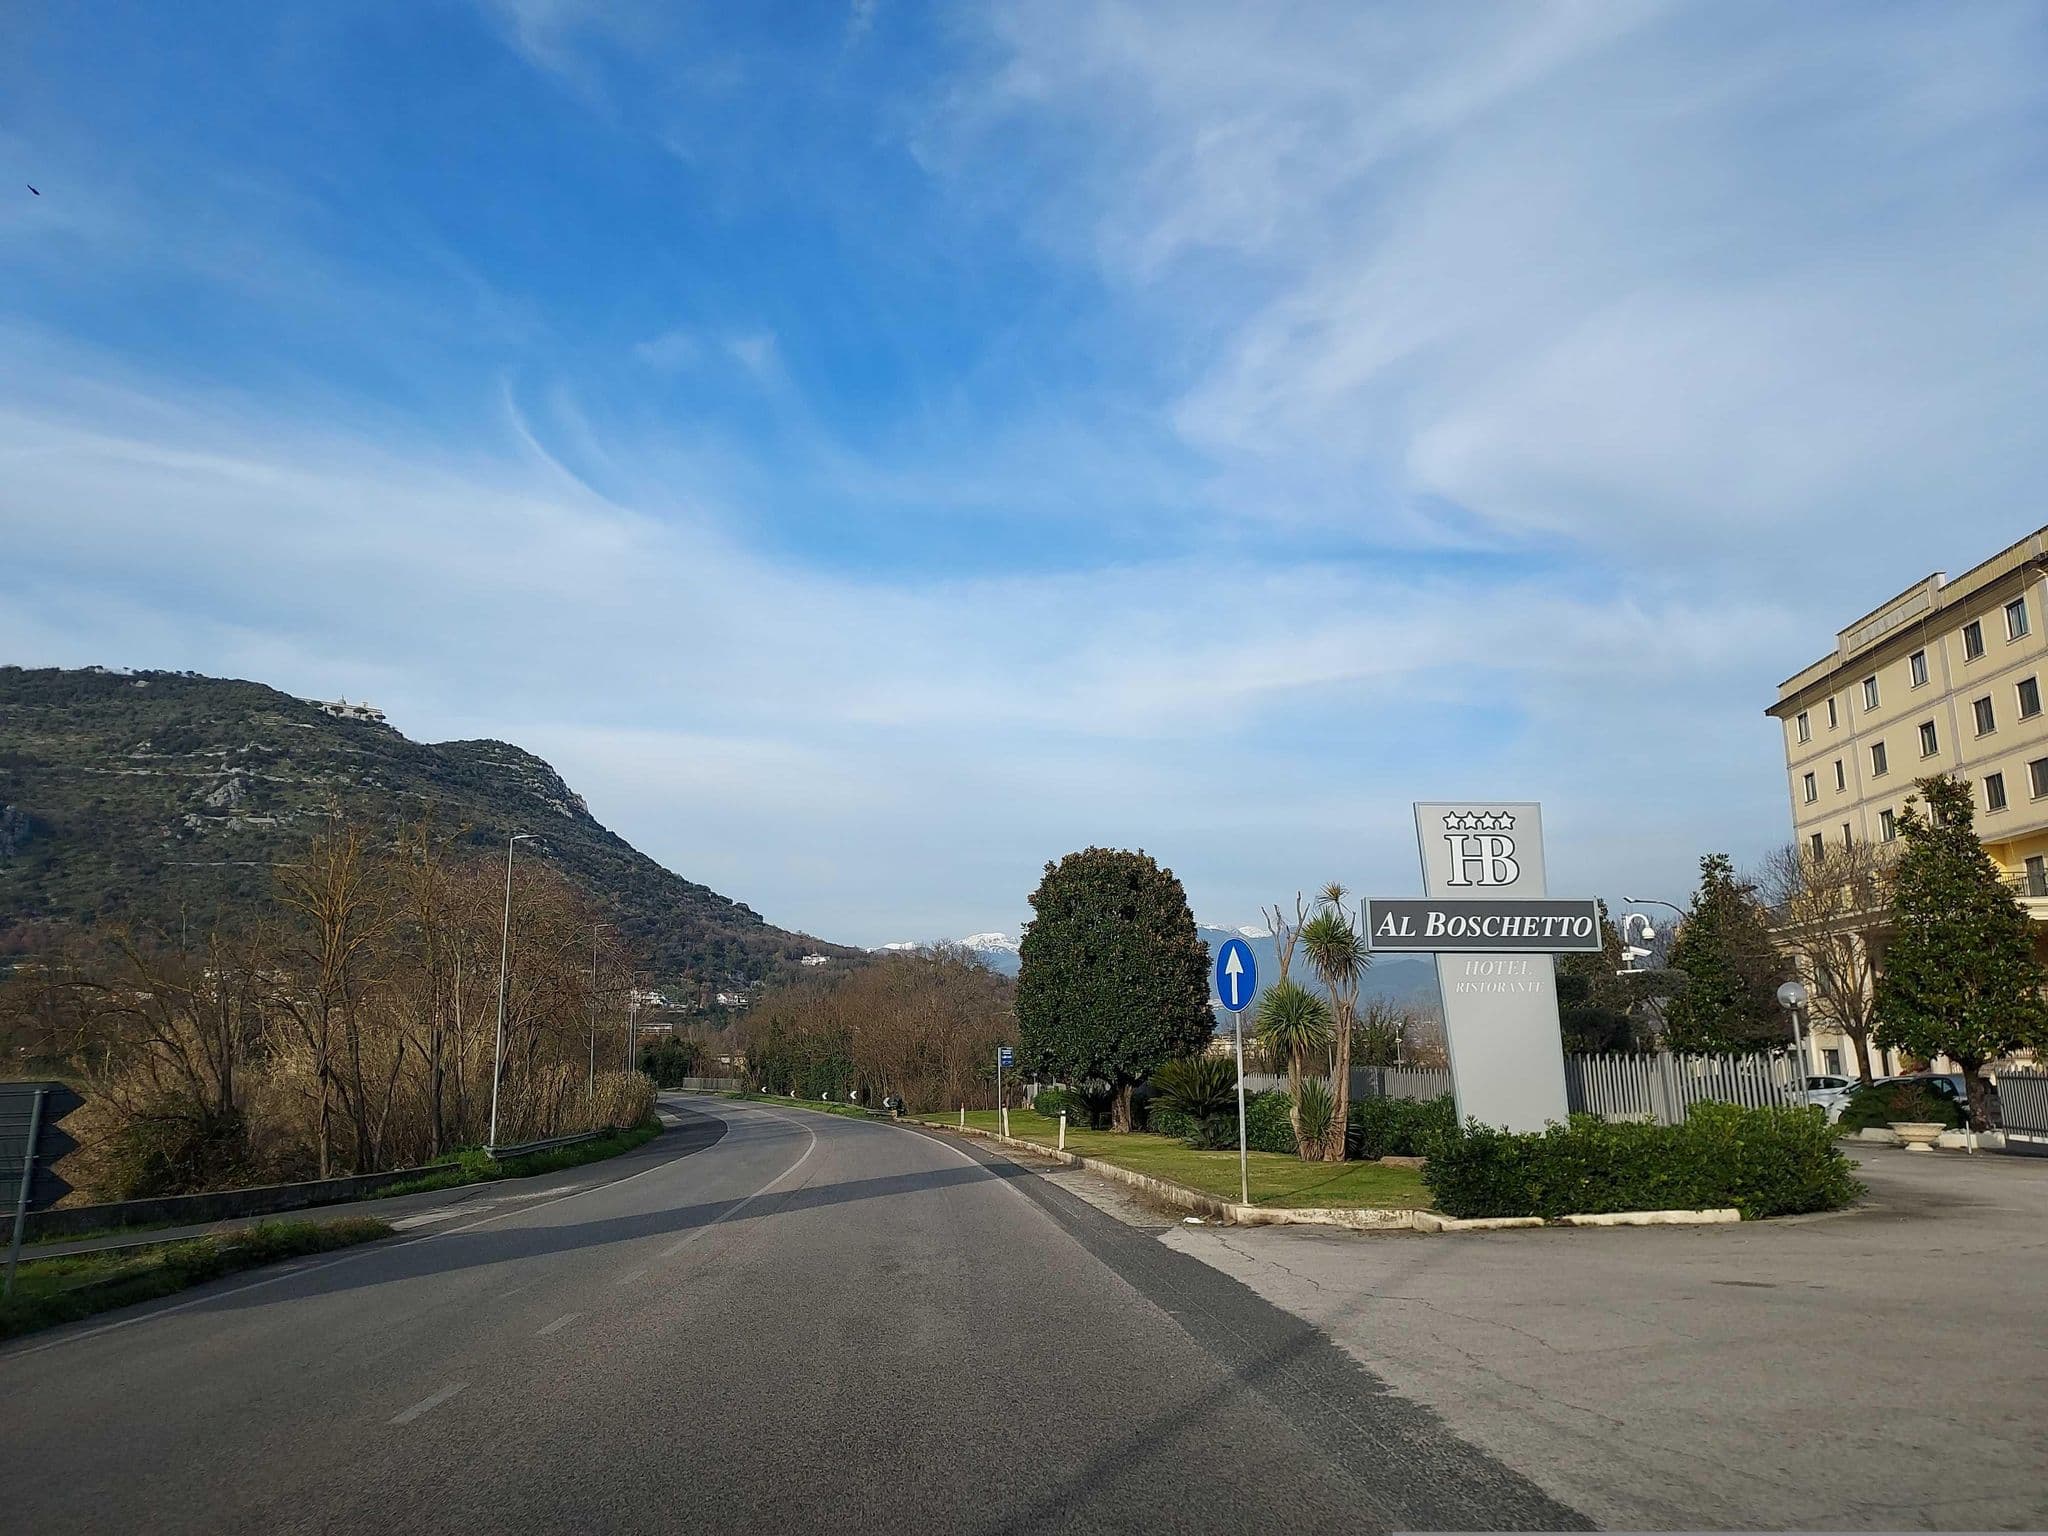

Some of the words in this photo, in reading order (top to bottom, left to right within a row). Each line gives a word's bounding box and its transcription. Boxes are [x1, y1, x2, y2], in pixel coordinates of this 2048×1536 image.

[1444, 833, 1520, 886] HB
[1375, 911, 1416, 937] AL
[1424, 911, 1593, 938] BOSCHETTO
[1464, 960, 1533, 976] HOTEL
